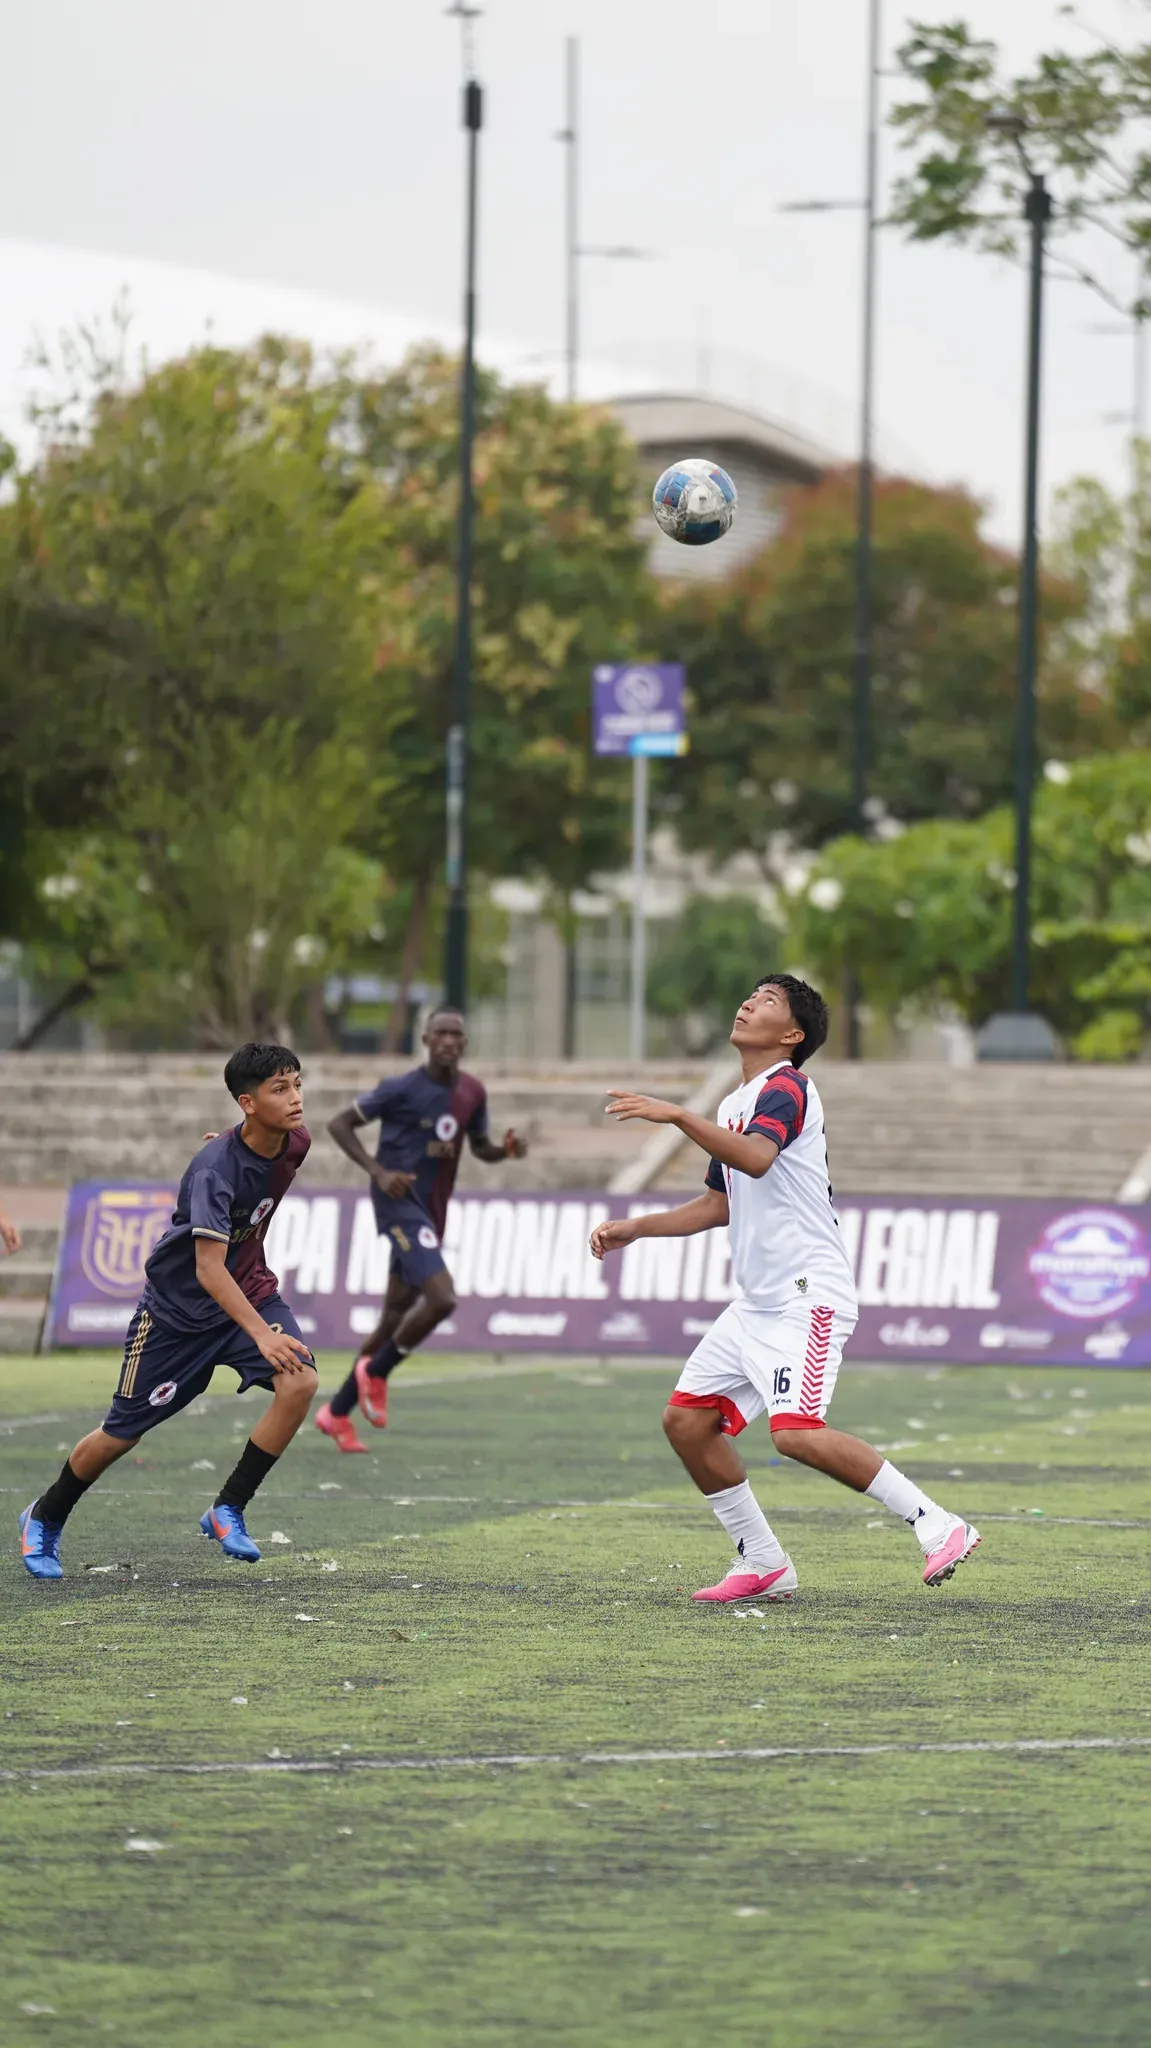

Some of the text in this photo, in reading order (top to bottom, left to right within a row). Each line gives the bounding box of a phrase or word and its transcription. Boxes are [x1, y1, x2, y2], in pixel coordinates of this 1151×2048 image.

[264, 1196, 340, 1295] PA
[345, 1197, 609, 1300] NCIONAL
[773, 1366, 792, 1396] 16
